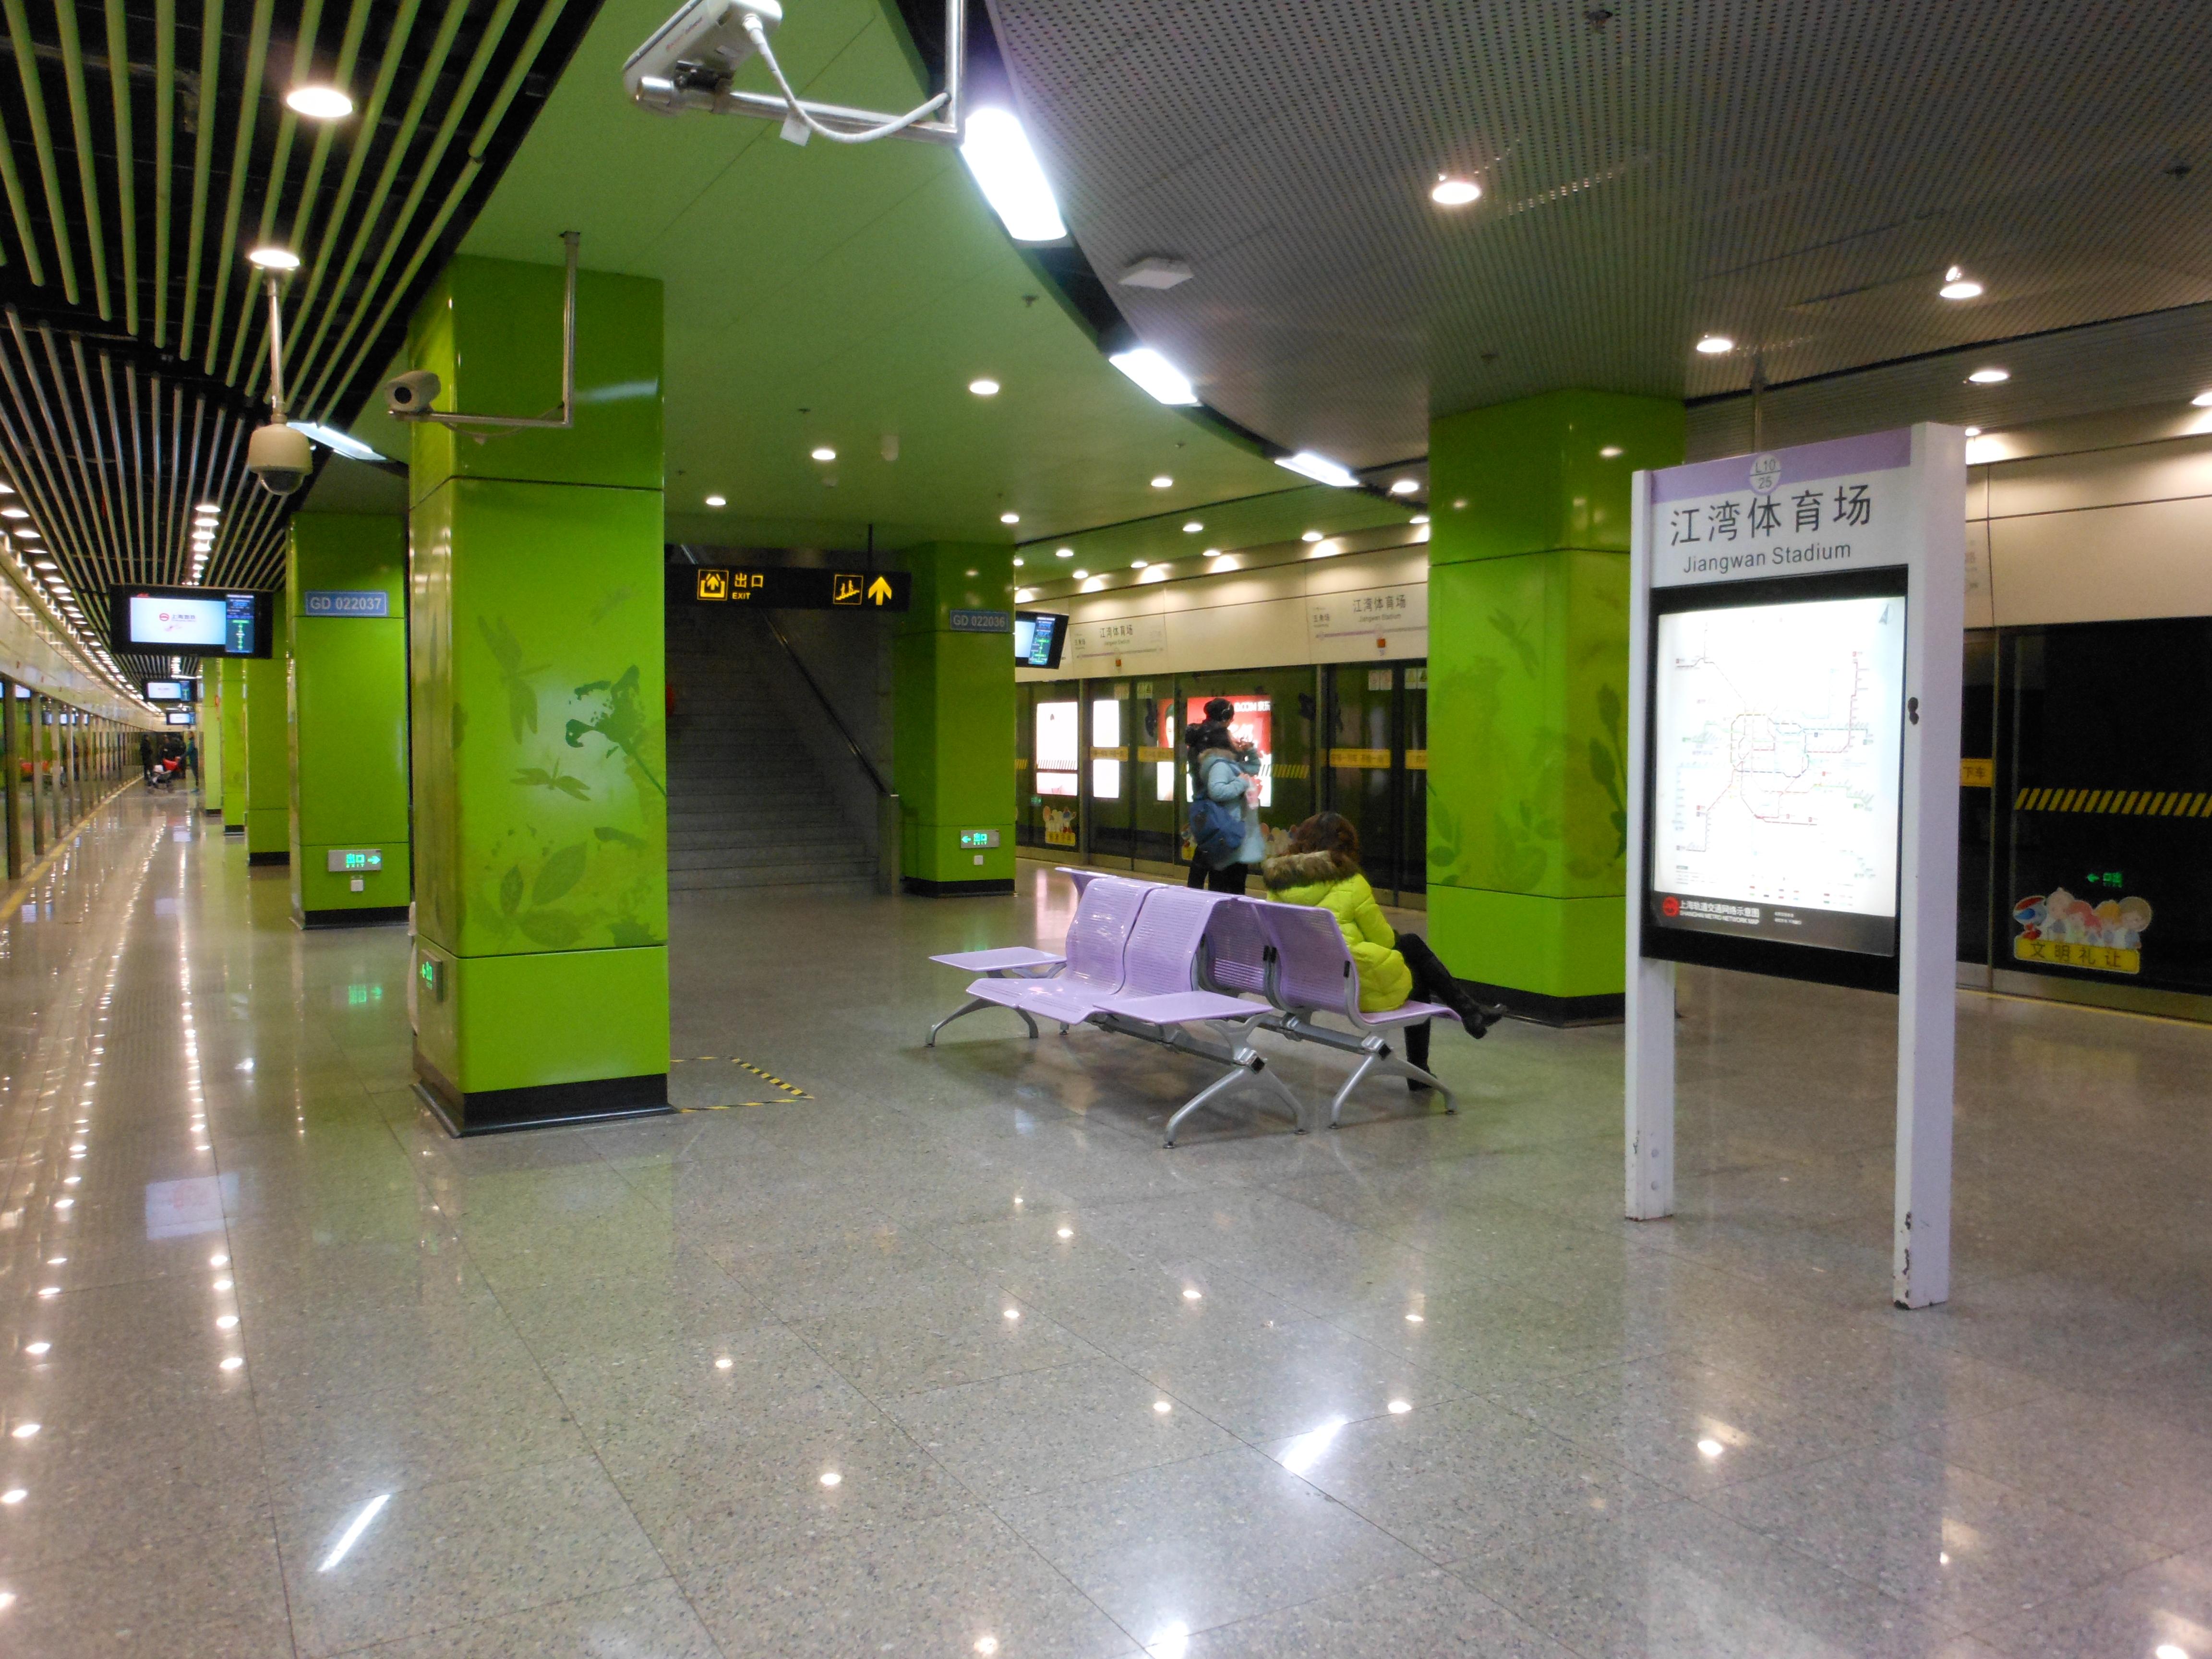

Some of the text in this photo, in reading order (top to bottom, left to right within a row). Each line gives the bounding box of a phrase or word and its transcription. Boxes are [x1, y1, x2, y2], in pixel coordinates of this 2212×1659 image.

[1755, 458, 1776, 473] L10
[1757, 477, 1773, 489] 25
[1671, 484, 1871, 546] 江湾体育场
[1683, 542, 1851, 575] Jiangwan Stadium
[734, 573, 763, 588] 出口
[310, 596, 382, 610] GD 022037
[1352, 594, 1406, 613] 江湾体育场
[953, 614, 1006, 627] GD 022036
[346, 853, 365, 864] 出口
[2030, 942, 2121, 967] 文明礼让
